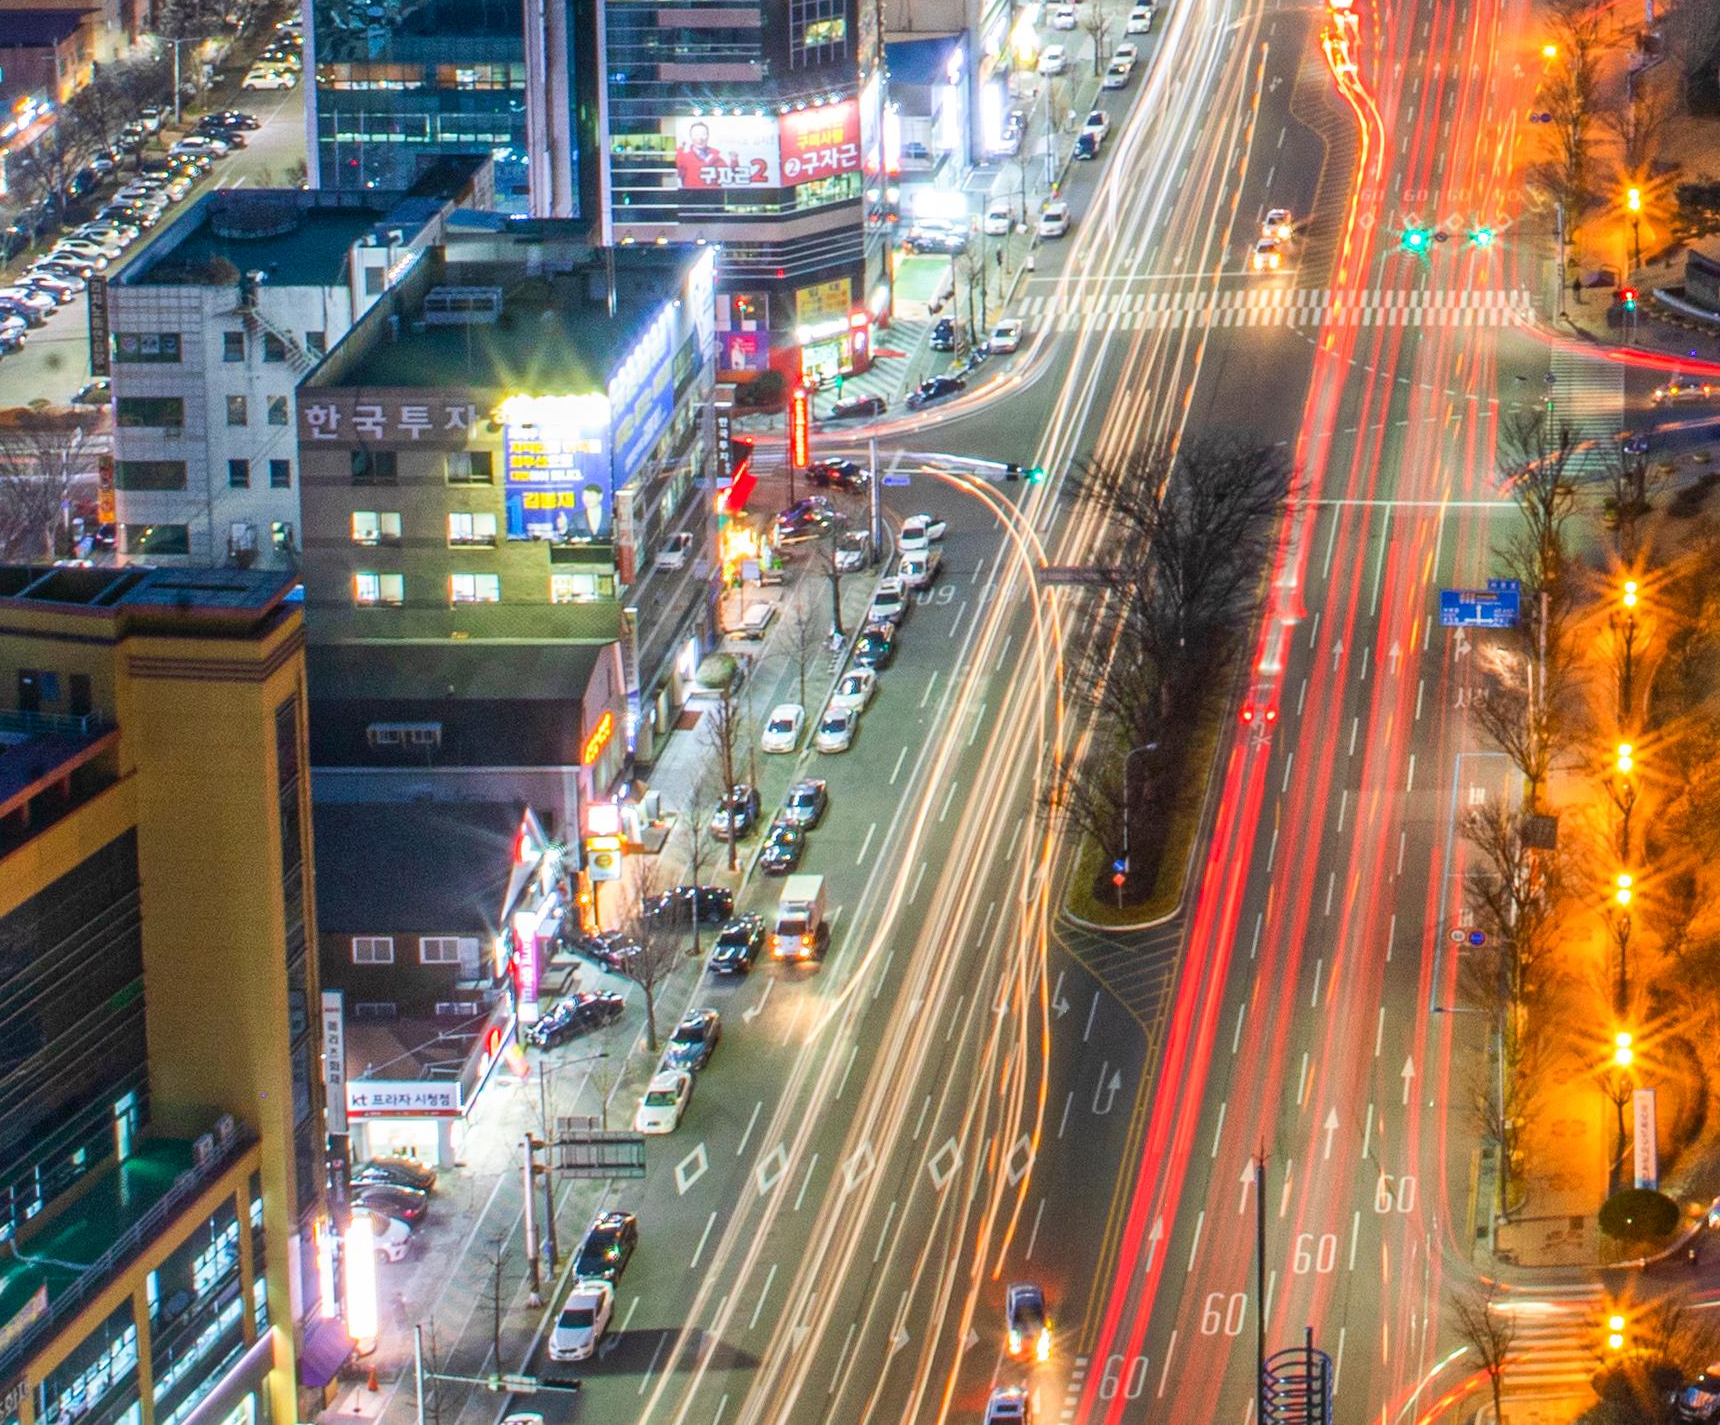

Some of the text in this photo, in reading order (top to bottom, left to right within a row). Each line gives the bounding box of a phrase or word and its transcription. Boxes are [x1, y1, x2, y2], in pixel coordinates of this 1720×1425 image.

[700, 158, 769, 185] 구자근 2
[800, 143, 858, 175] 구자근
[352, 1094, 368, 1106] kt
[372, 1094, 411, 1106] 프라자
[1374, 1175, 1417, 1214] 60
[1292, 1233, 1337, 1274] 60
[1201, 1292, 1248, 1336] 60
[1098, 1354, 1149, 1399] 60
